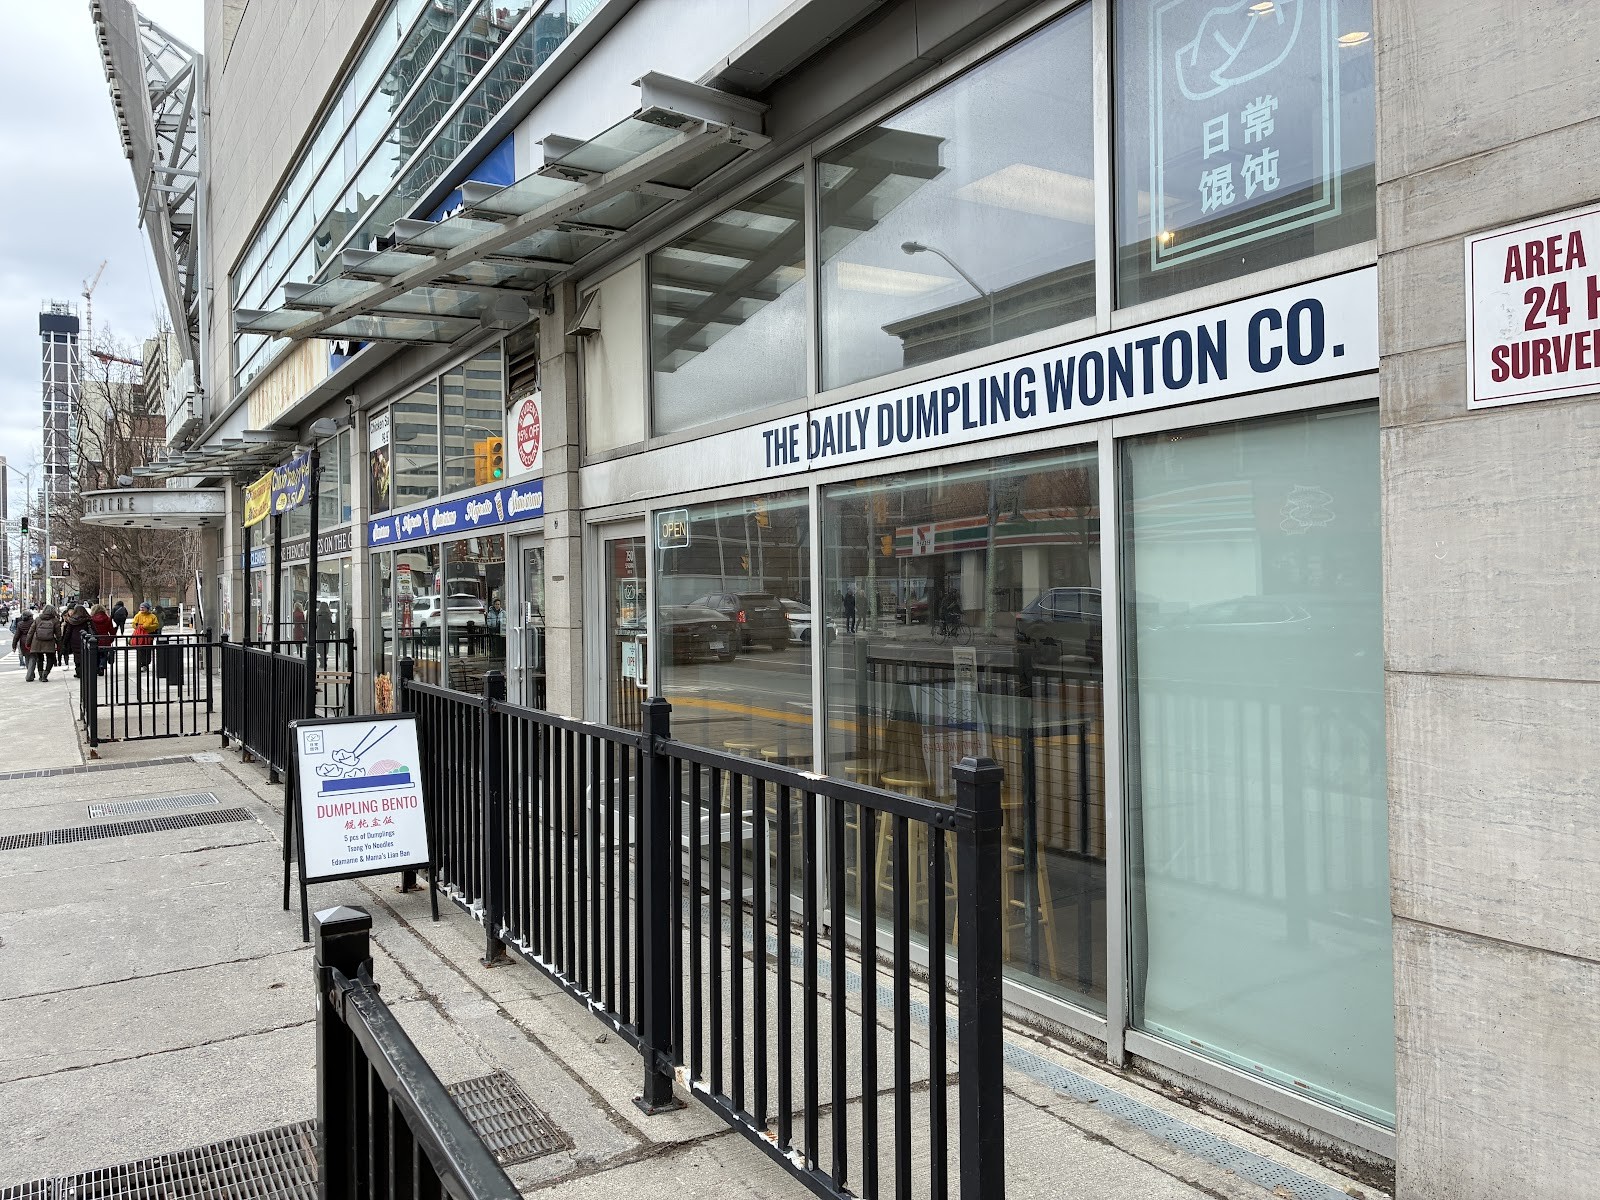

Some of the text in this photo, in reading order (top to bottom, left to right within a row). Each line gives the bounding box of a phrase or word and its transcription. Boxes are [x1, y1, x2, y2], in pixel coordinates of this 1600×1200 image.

[1203, 95, 1279, 160] 日常
[1198, 147, 1281, 214] 馄饨
[1503, 230, 1586, 284] AREA
[1523, 281, 1570, 331] 24
[763, 298, 1345, 468] THE DAILY DUMPLING WONTON CO.
[518, 424, 540, 442] 15% OFF
[663, 522, 685, 538] OPEN
[325, 535, 333, 552] ON
[334, 533, 346, 551] THE
[317, 796, 417, 818] DUMPLING BENTO
[350, 834, 359, 842] pcs
[360, 832, 366, 840] of
[367, 830, 395, 839] Dumplings
[373, 841, 394, 849] Noodles
